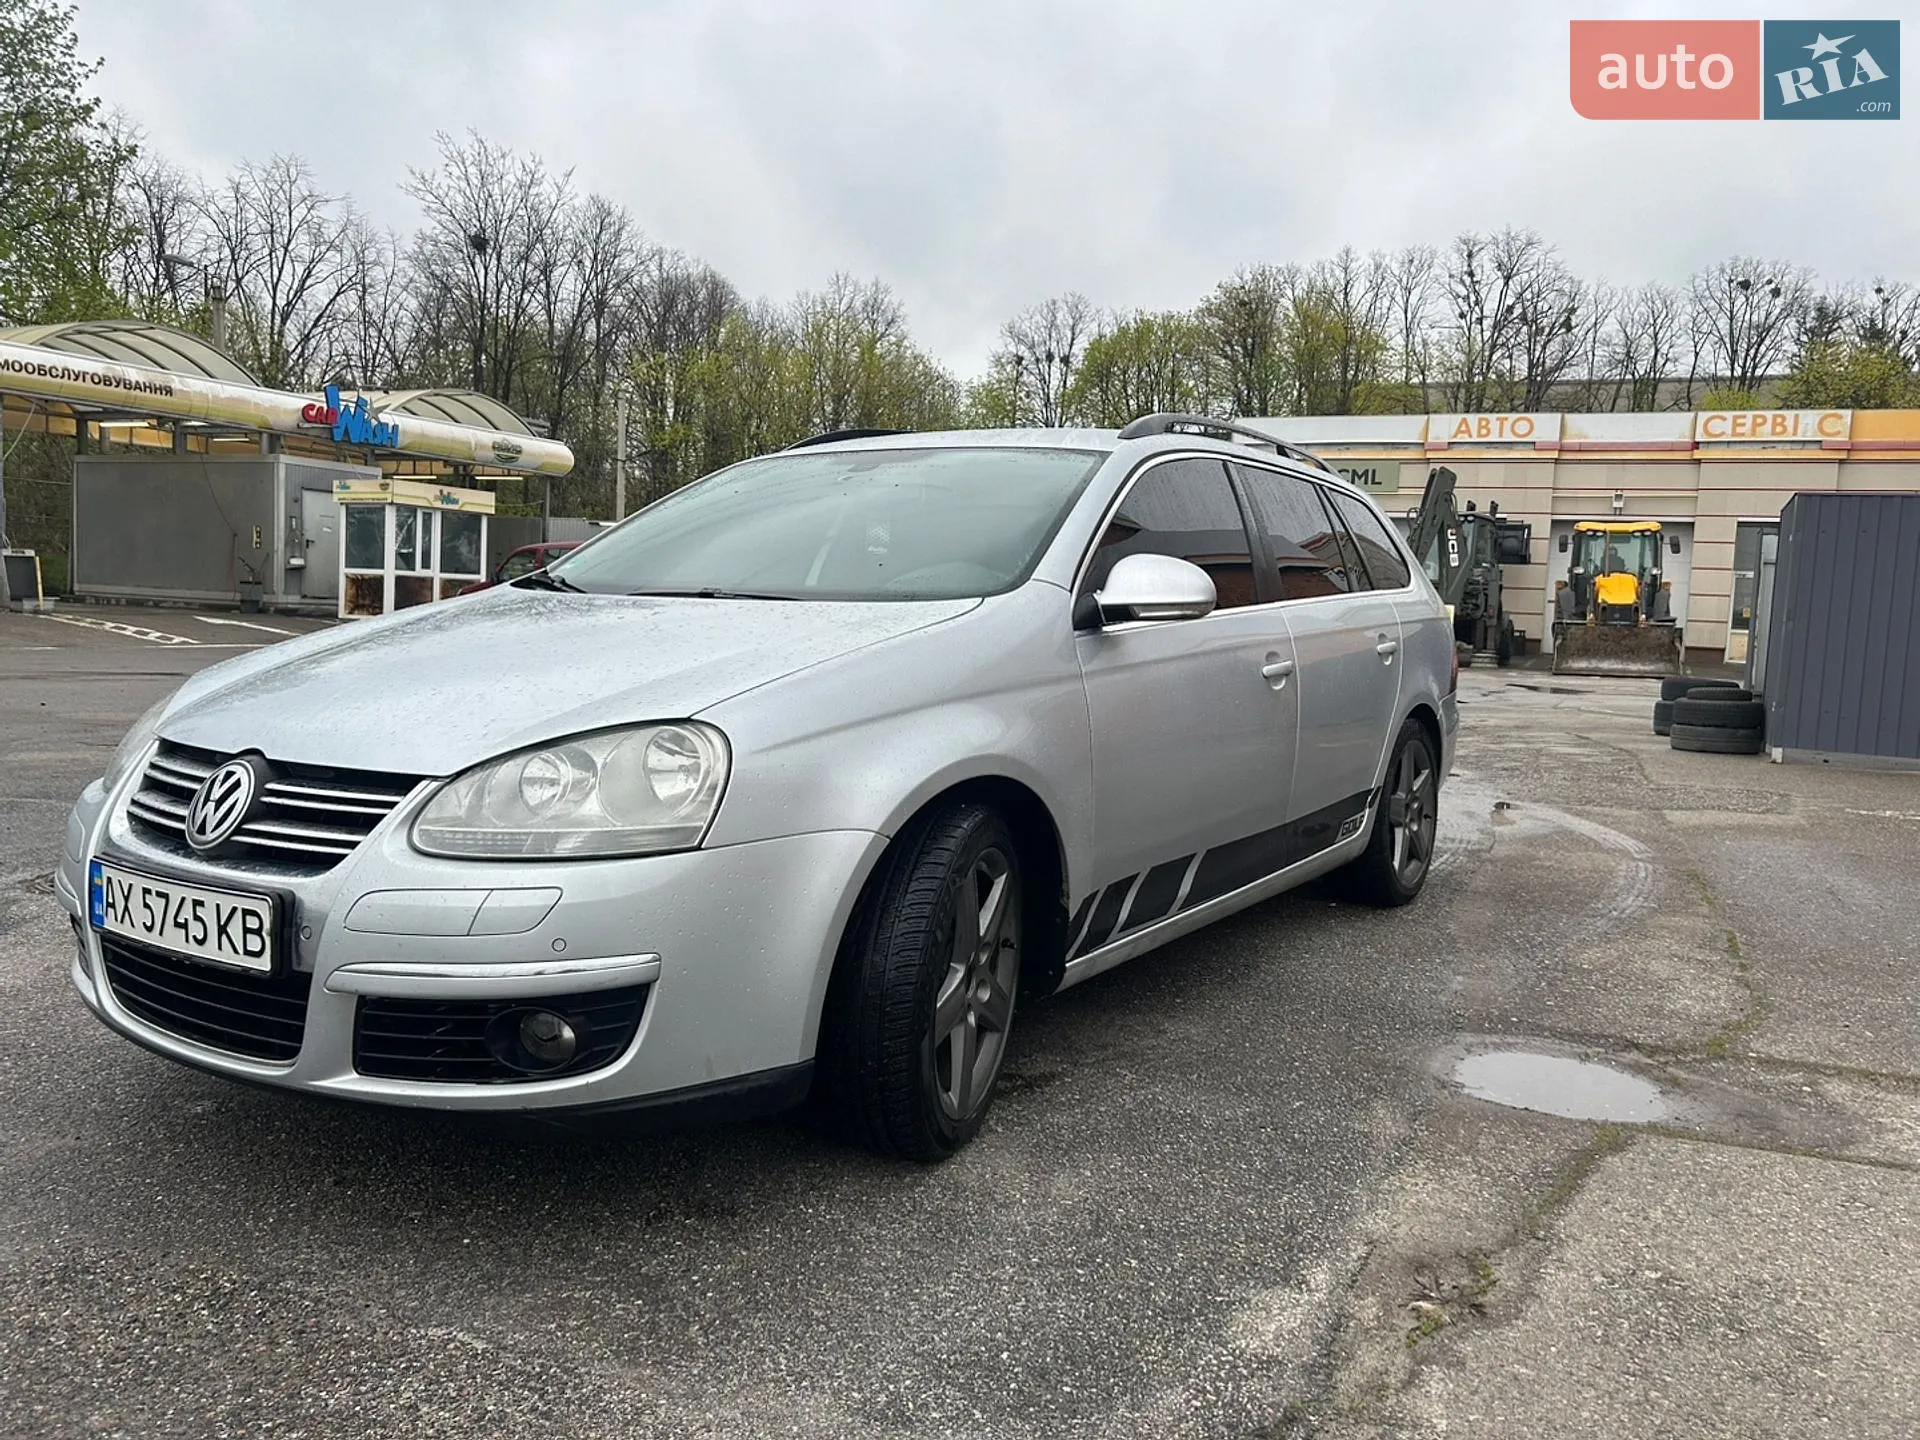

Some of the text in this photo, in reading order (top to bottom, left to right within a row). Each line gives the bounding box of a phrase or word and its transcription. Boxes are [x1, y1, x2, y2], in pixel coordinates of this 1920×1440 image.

[1452, 416, 1535, 438] АВТО
[1447, 528, 1459, 567] JCB
[105, 875, 266, 958] AX 5745 KB
